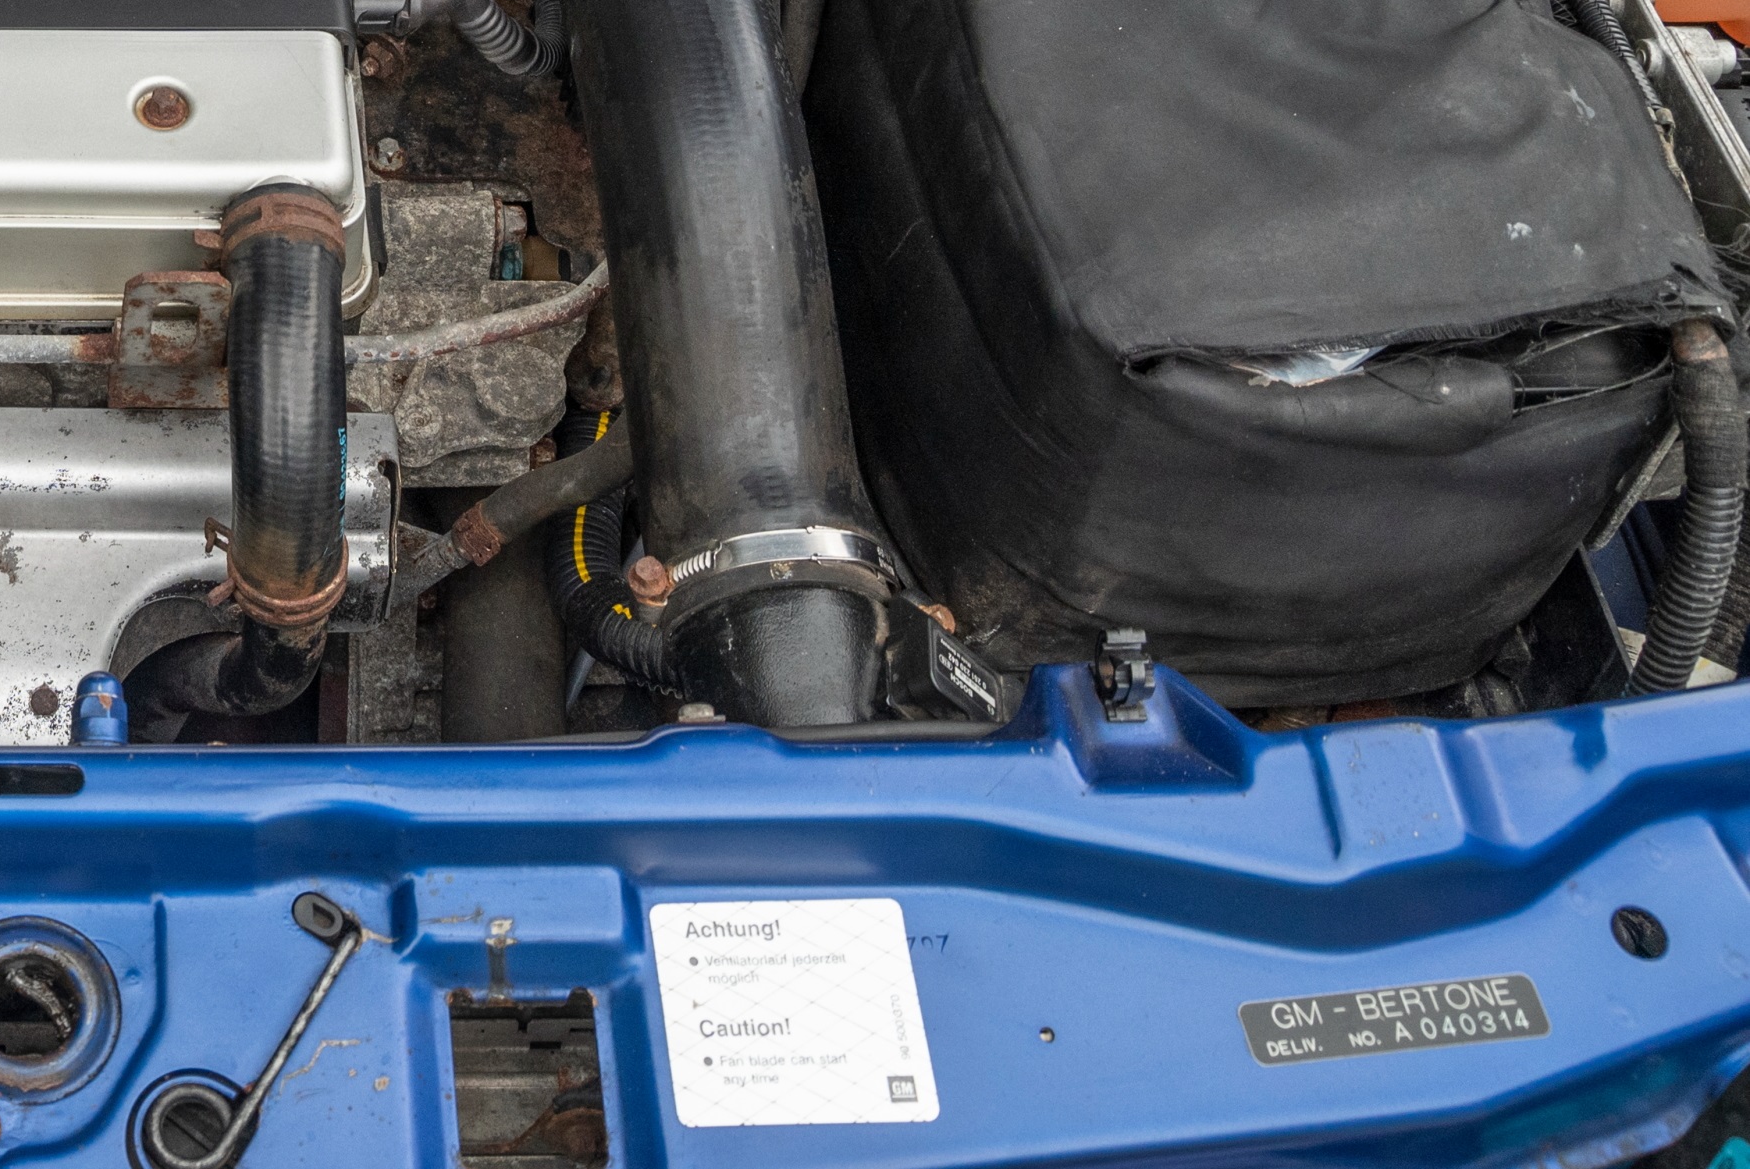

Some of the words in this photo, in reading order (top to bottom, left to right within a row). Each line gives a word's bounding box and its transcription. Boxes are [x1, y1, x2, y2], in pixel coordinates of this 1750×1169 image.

[950, 672, 973, 698] BOSCH
[685, 919, 781, 941] Achtung!
[704, 953, 787, 967] Ventilatorlauf
[792, 953, 847, 967] jederzeit
[708, 971, 759, 986] möglich
[1271, 1000, 1323, 1029] GM
[1355, 978, 1517, 1021] BERTONE
[699, 1017, 791, 1038] Caution!
[1266, 1037, 1323, 1057] DELIV.
[1348, 1030, 1382, 1048] NO.
[1394, 1022, 1413, 1043] A
[1419, 1008, 1530, 1040] 040314
[719, 1055, 744, 1067] Fan
[749, 1055, 785, 1067] blade
[791, 1055, 815, 1066] can
[819, 1053, 848, 1065] start
[723, 1075, 746, 1088] any
[751, 1073, 780, 1085] time
[891, 1081, 914, 1097] GM
